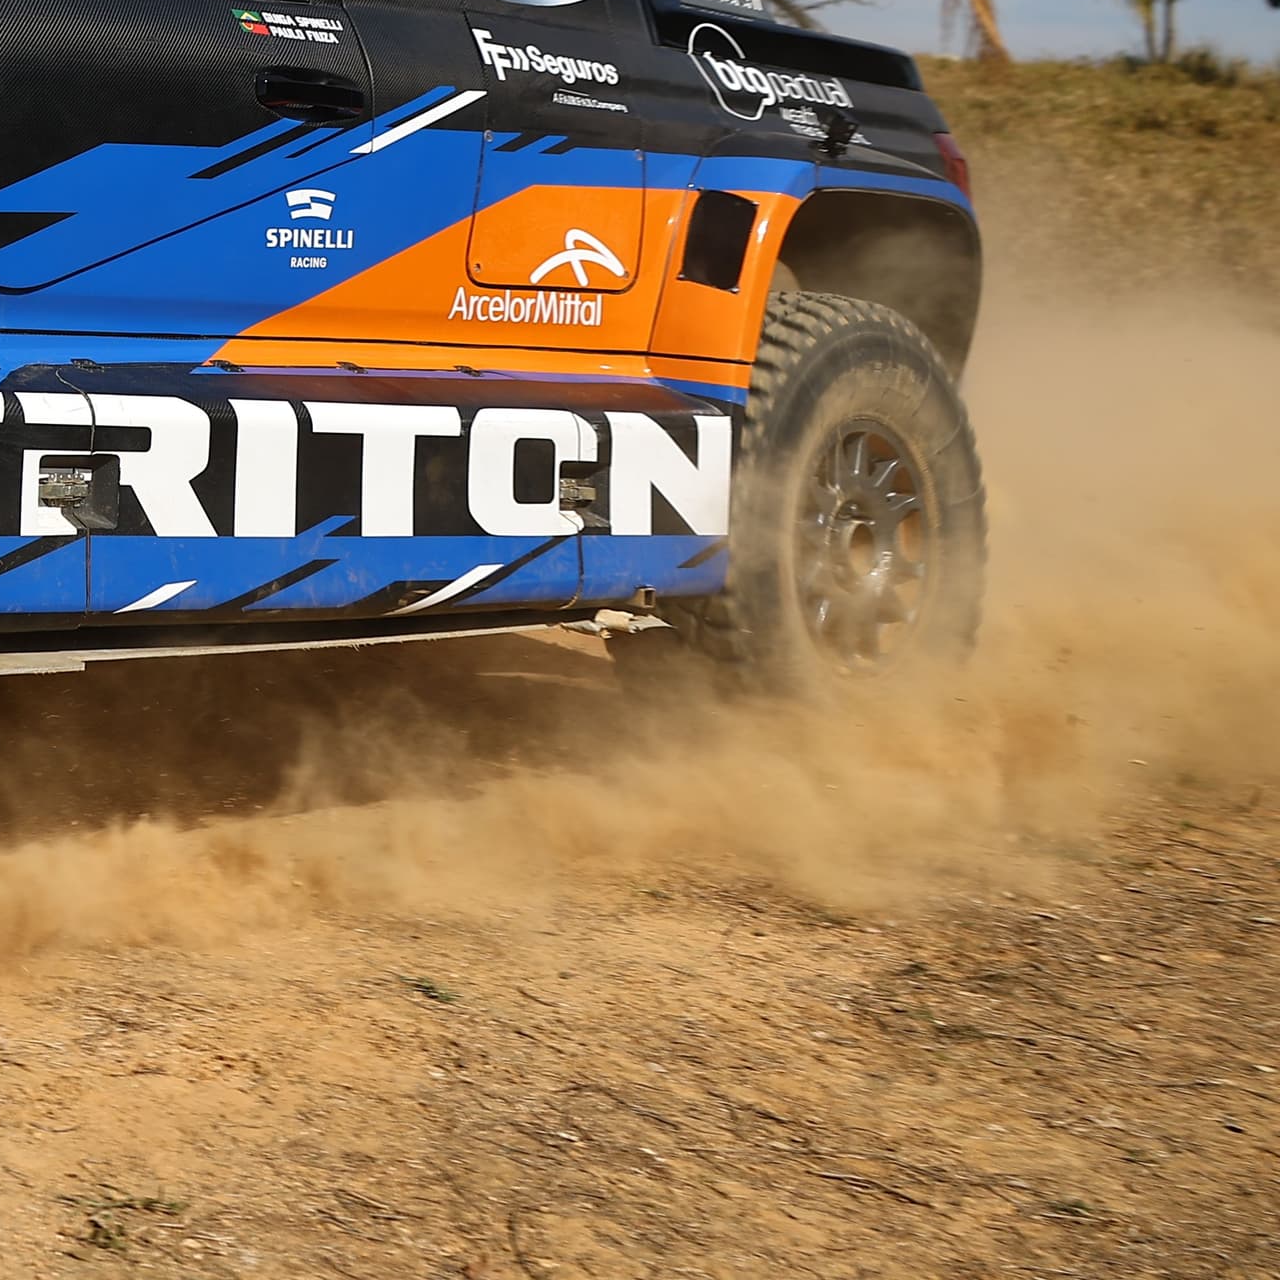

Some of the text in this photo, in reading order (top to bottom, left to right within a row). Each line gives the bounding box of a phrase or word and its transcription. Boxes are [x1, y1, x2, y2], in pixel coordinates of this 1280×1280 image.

[295, 16, 344, 32] SPINELLI
[269, 26, 307, 42] PAULO
[525, 45, 619, 84] Seguros
[266, 228, 353, 249] SPINELLI
[290, 257, 327, 268] RACING
[448, 286, 603, 326] ArcelorMittal
